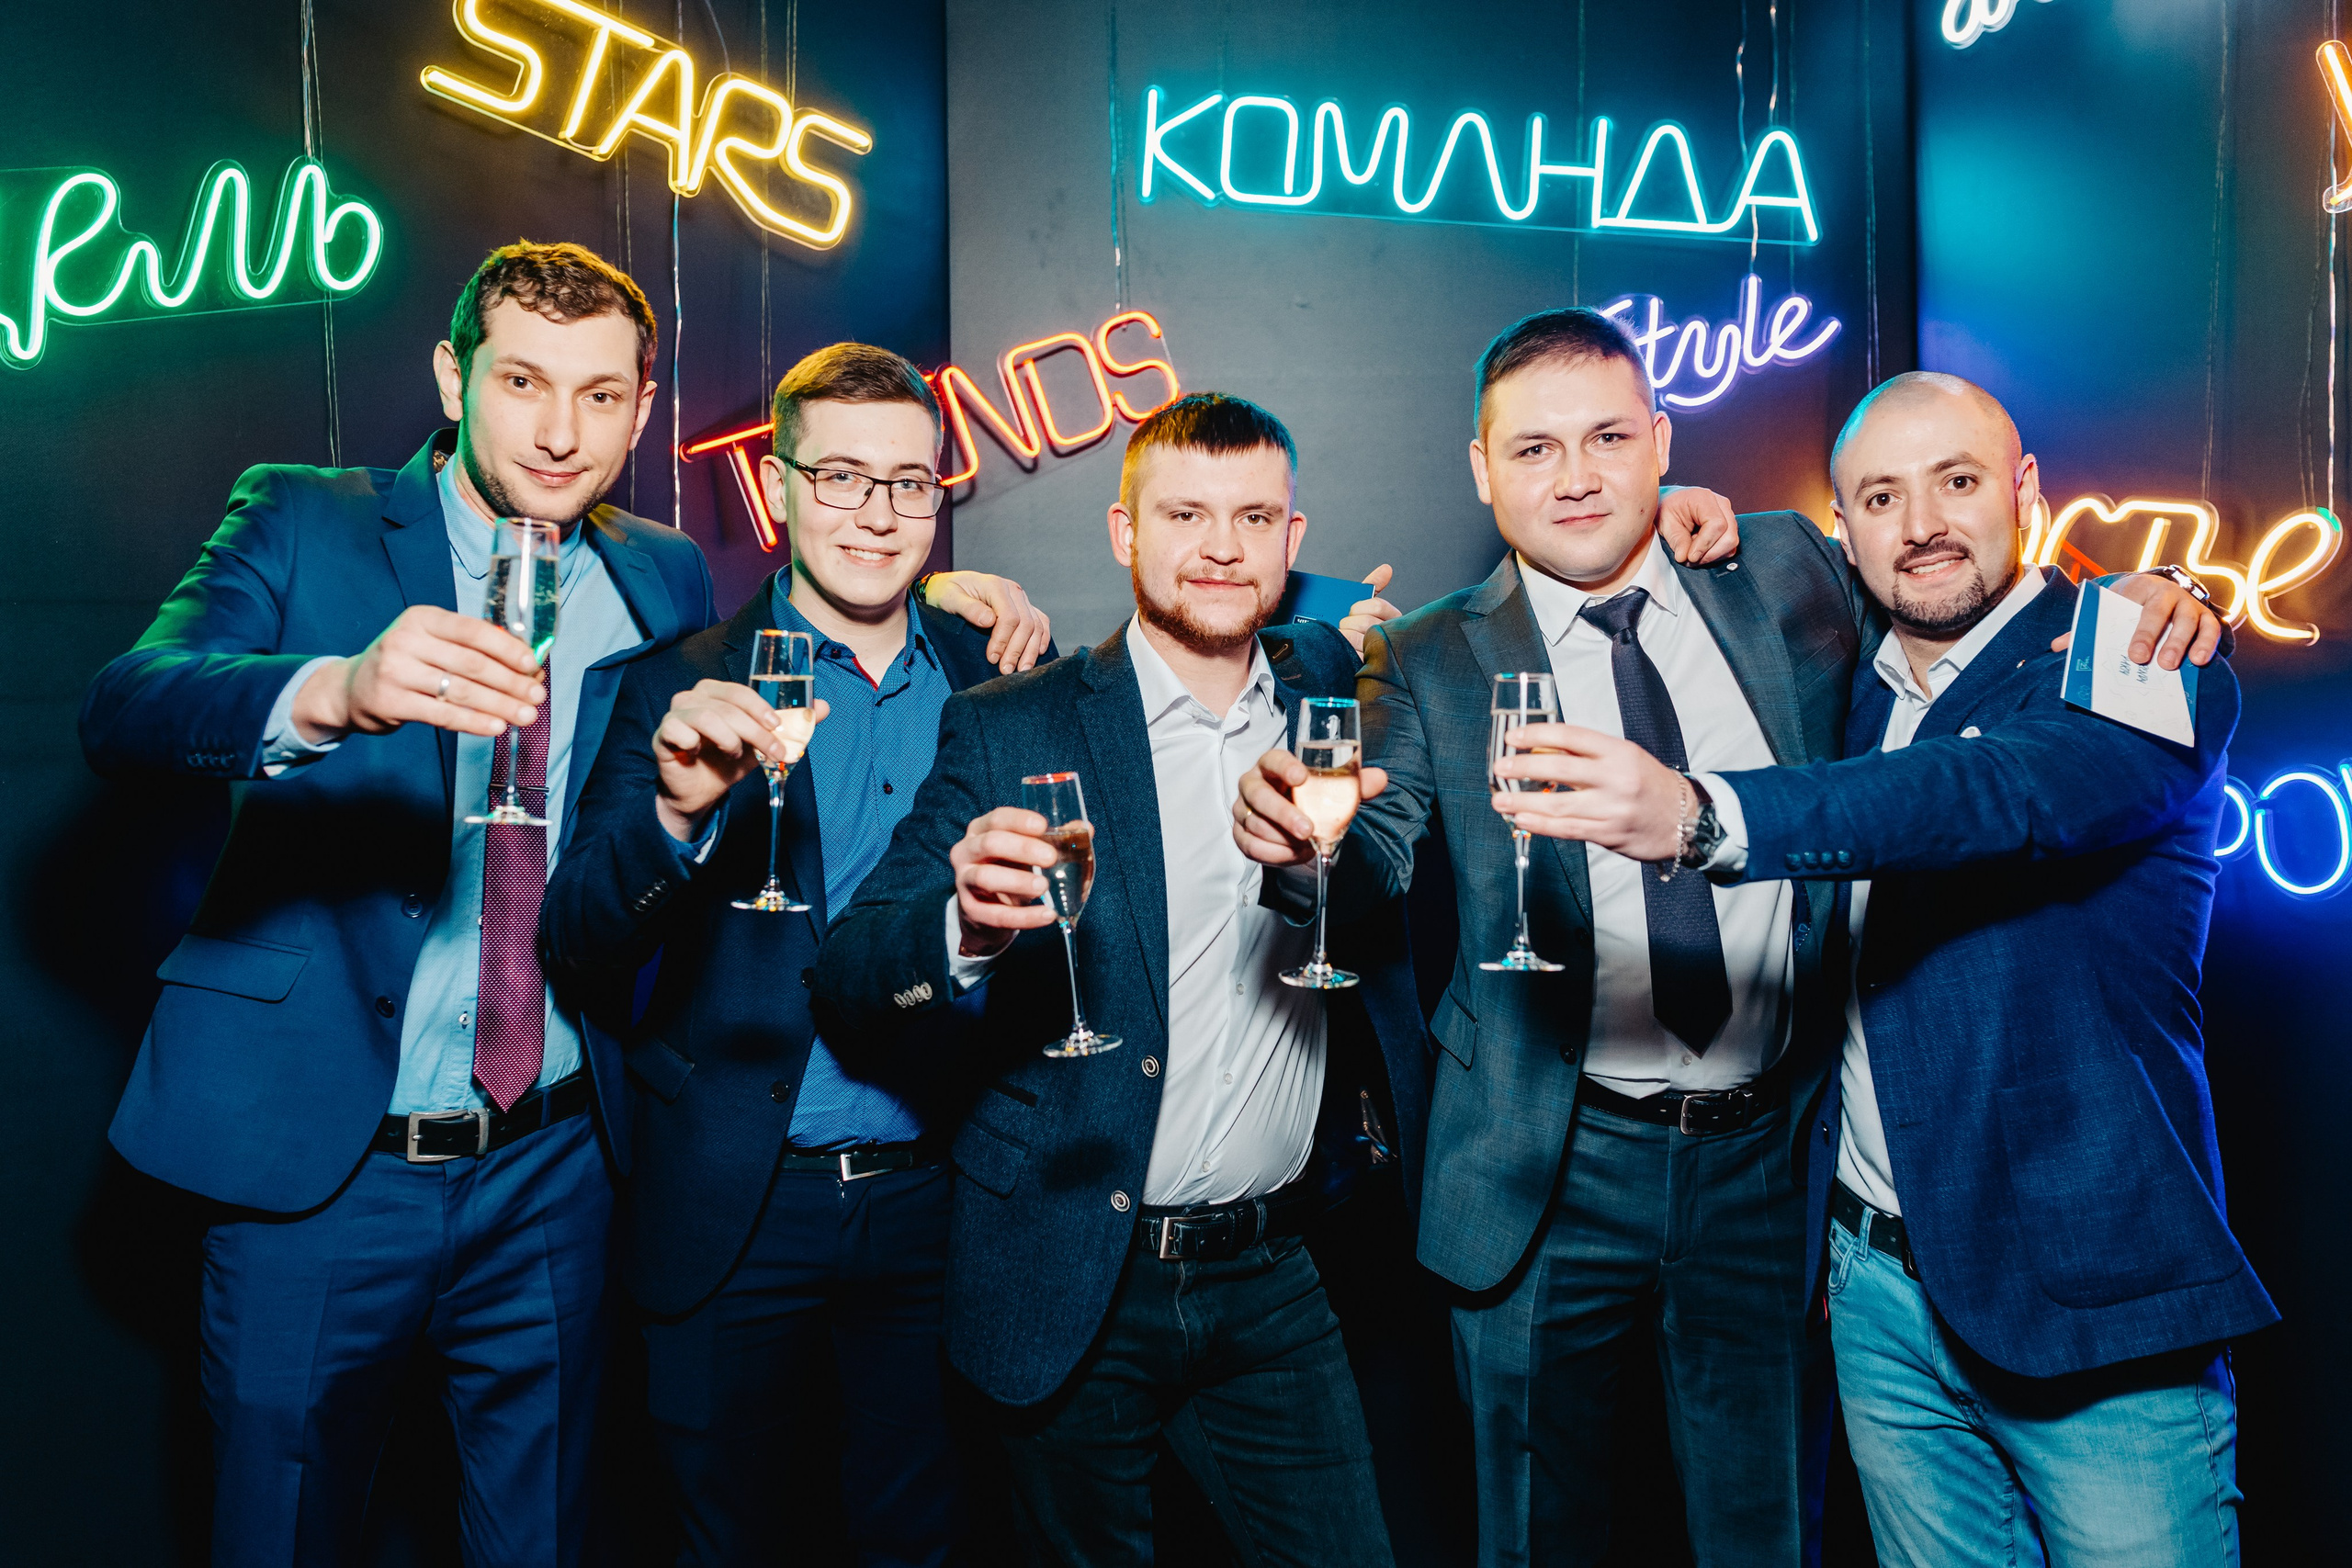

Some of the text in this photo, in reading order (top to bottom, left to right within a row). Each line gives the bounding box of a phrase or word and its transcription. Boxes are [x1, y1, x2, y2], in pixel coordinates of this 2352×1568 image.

[423, 0, 872, 245] STARS
[1141, 86, 1820, 242] КОМАНДА
[680, 310, 1180, 551] TNDS
[1595, 273, 1841, 407] tyle
